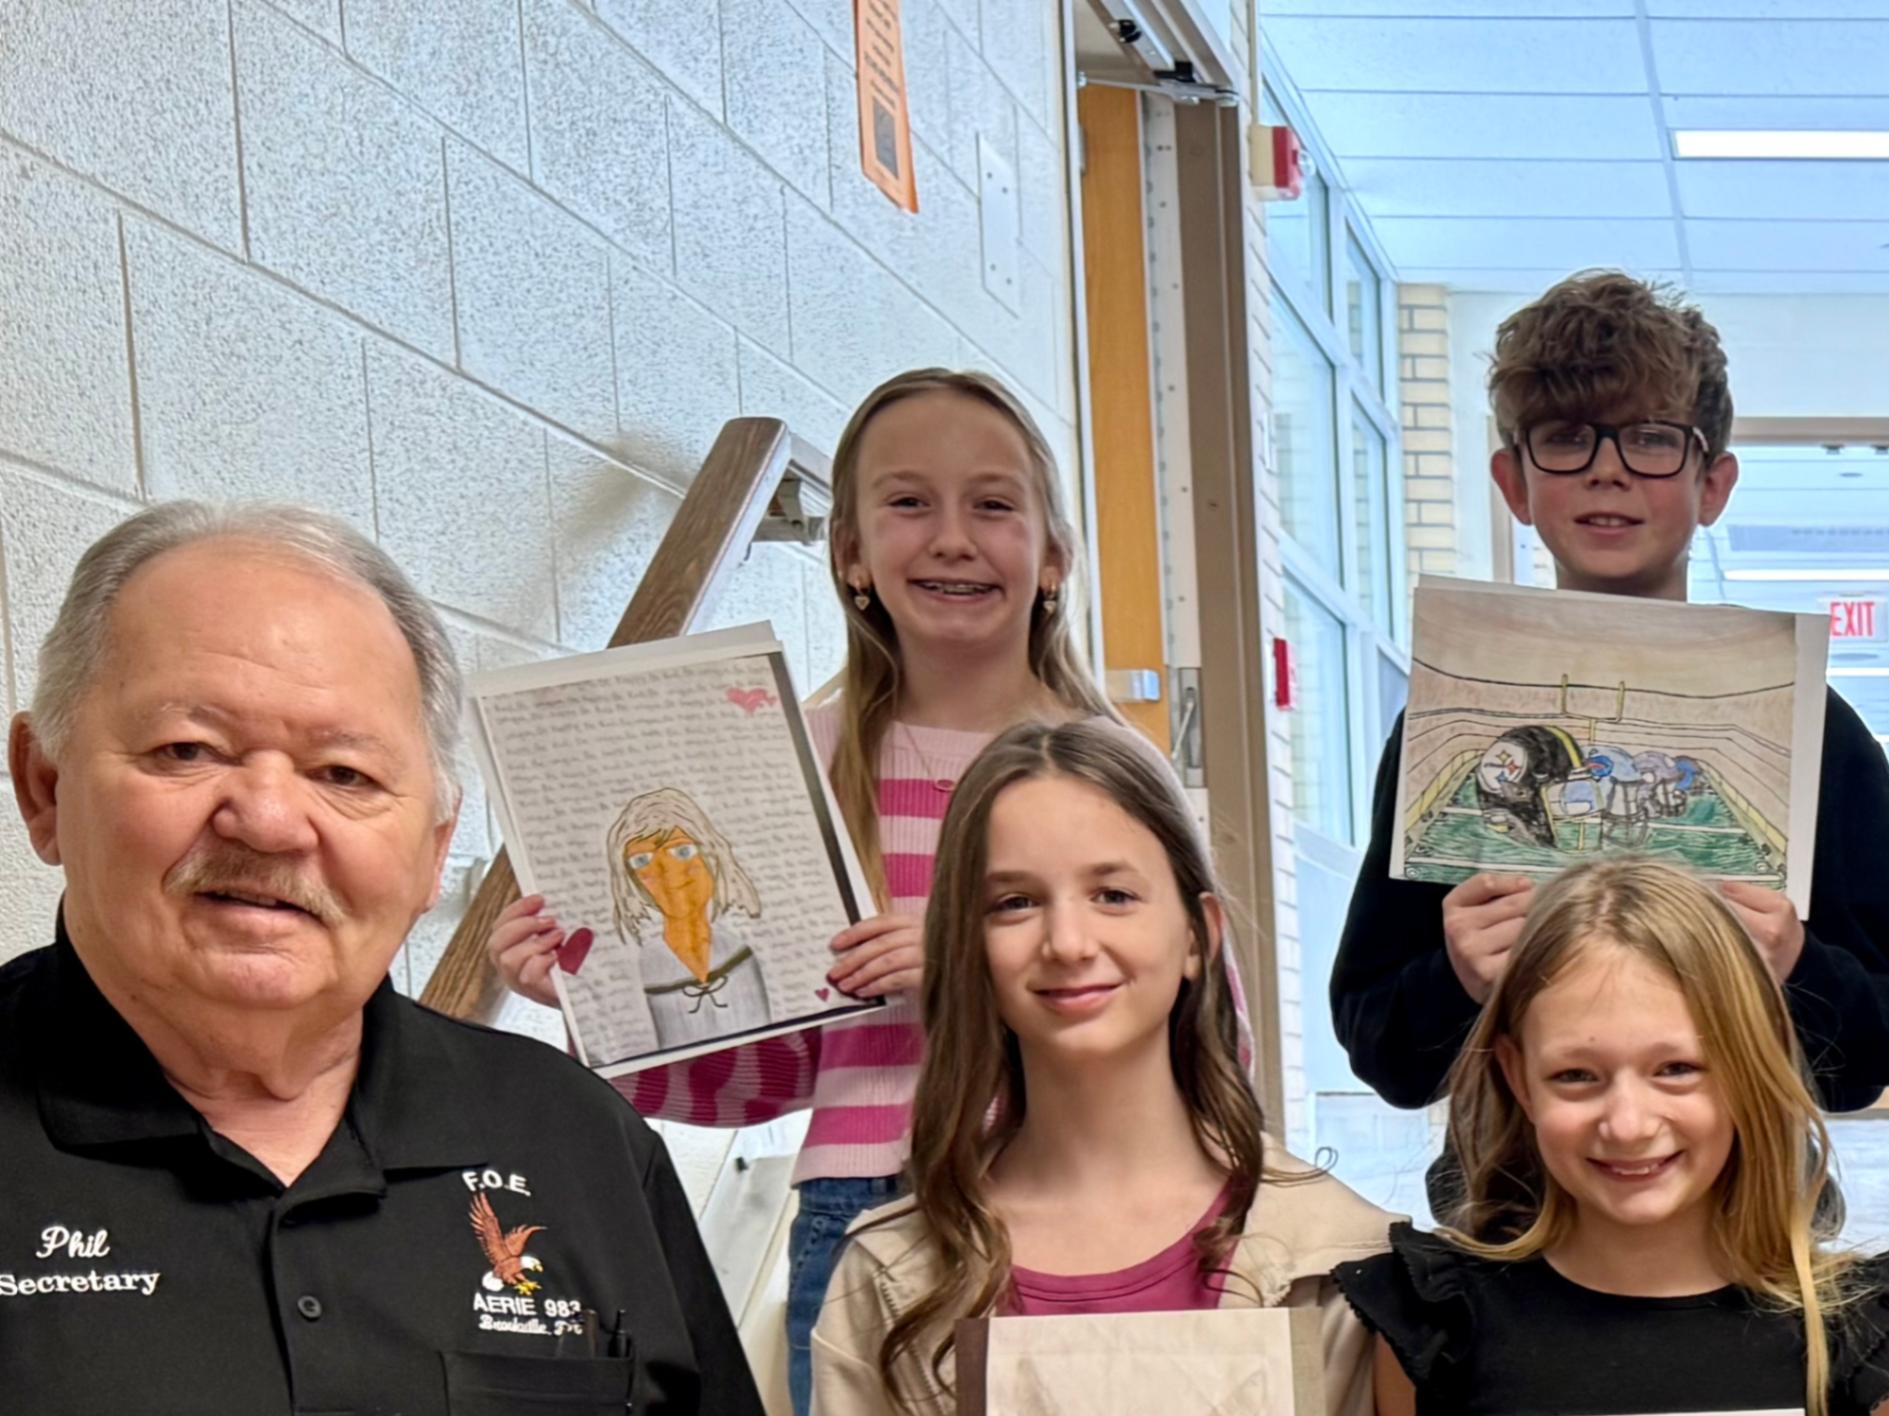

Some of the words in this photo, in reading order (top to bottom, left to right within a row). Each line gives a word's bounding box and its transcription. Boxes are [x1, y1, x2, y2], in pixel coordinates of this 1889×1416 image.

[1829, 601, 1875, 637] EXIT
[35, 1225, 111, 1259] Phil
[0, 1269, 161, 1296] Secretary
[473, 1292, 537, 1316] AERIE
